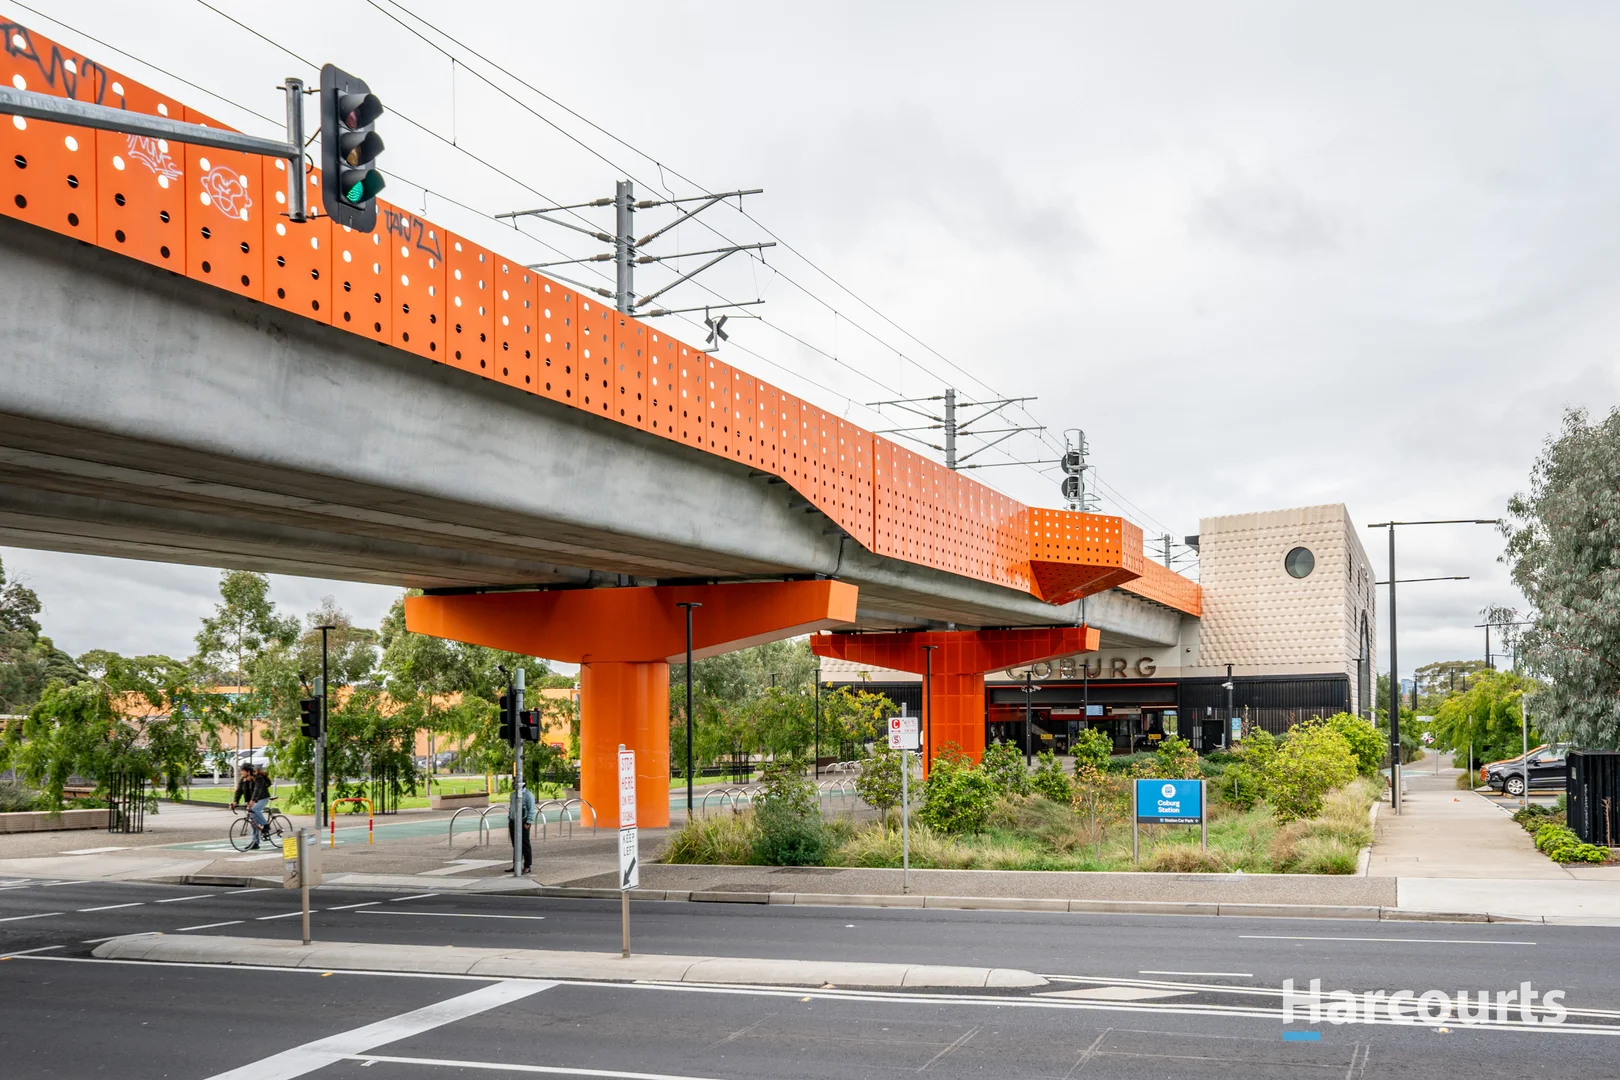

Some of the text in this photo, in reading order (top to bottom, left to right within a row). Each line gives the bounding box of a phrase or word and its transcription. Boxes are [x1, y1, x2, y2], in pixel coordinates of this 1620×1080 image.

[621, 757, 633, 771] STOP
[621, 775, 634, 790] HERE
[622, 833, 635, 844] KEEP
[623, 845, 635, 857] LEFT
